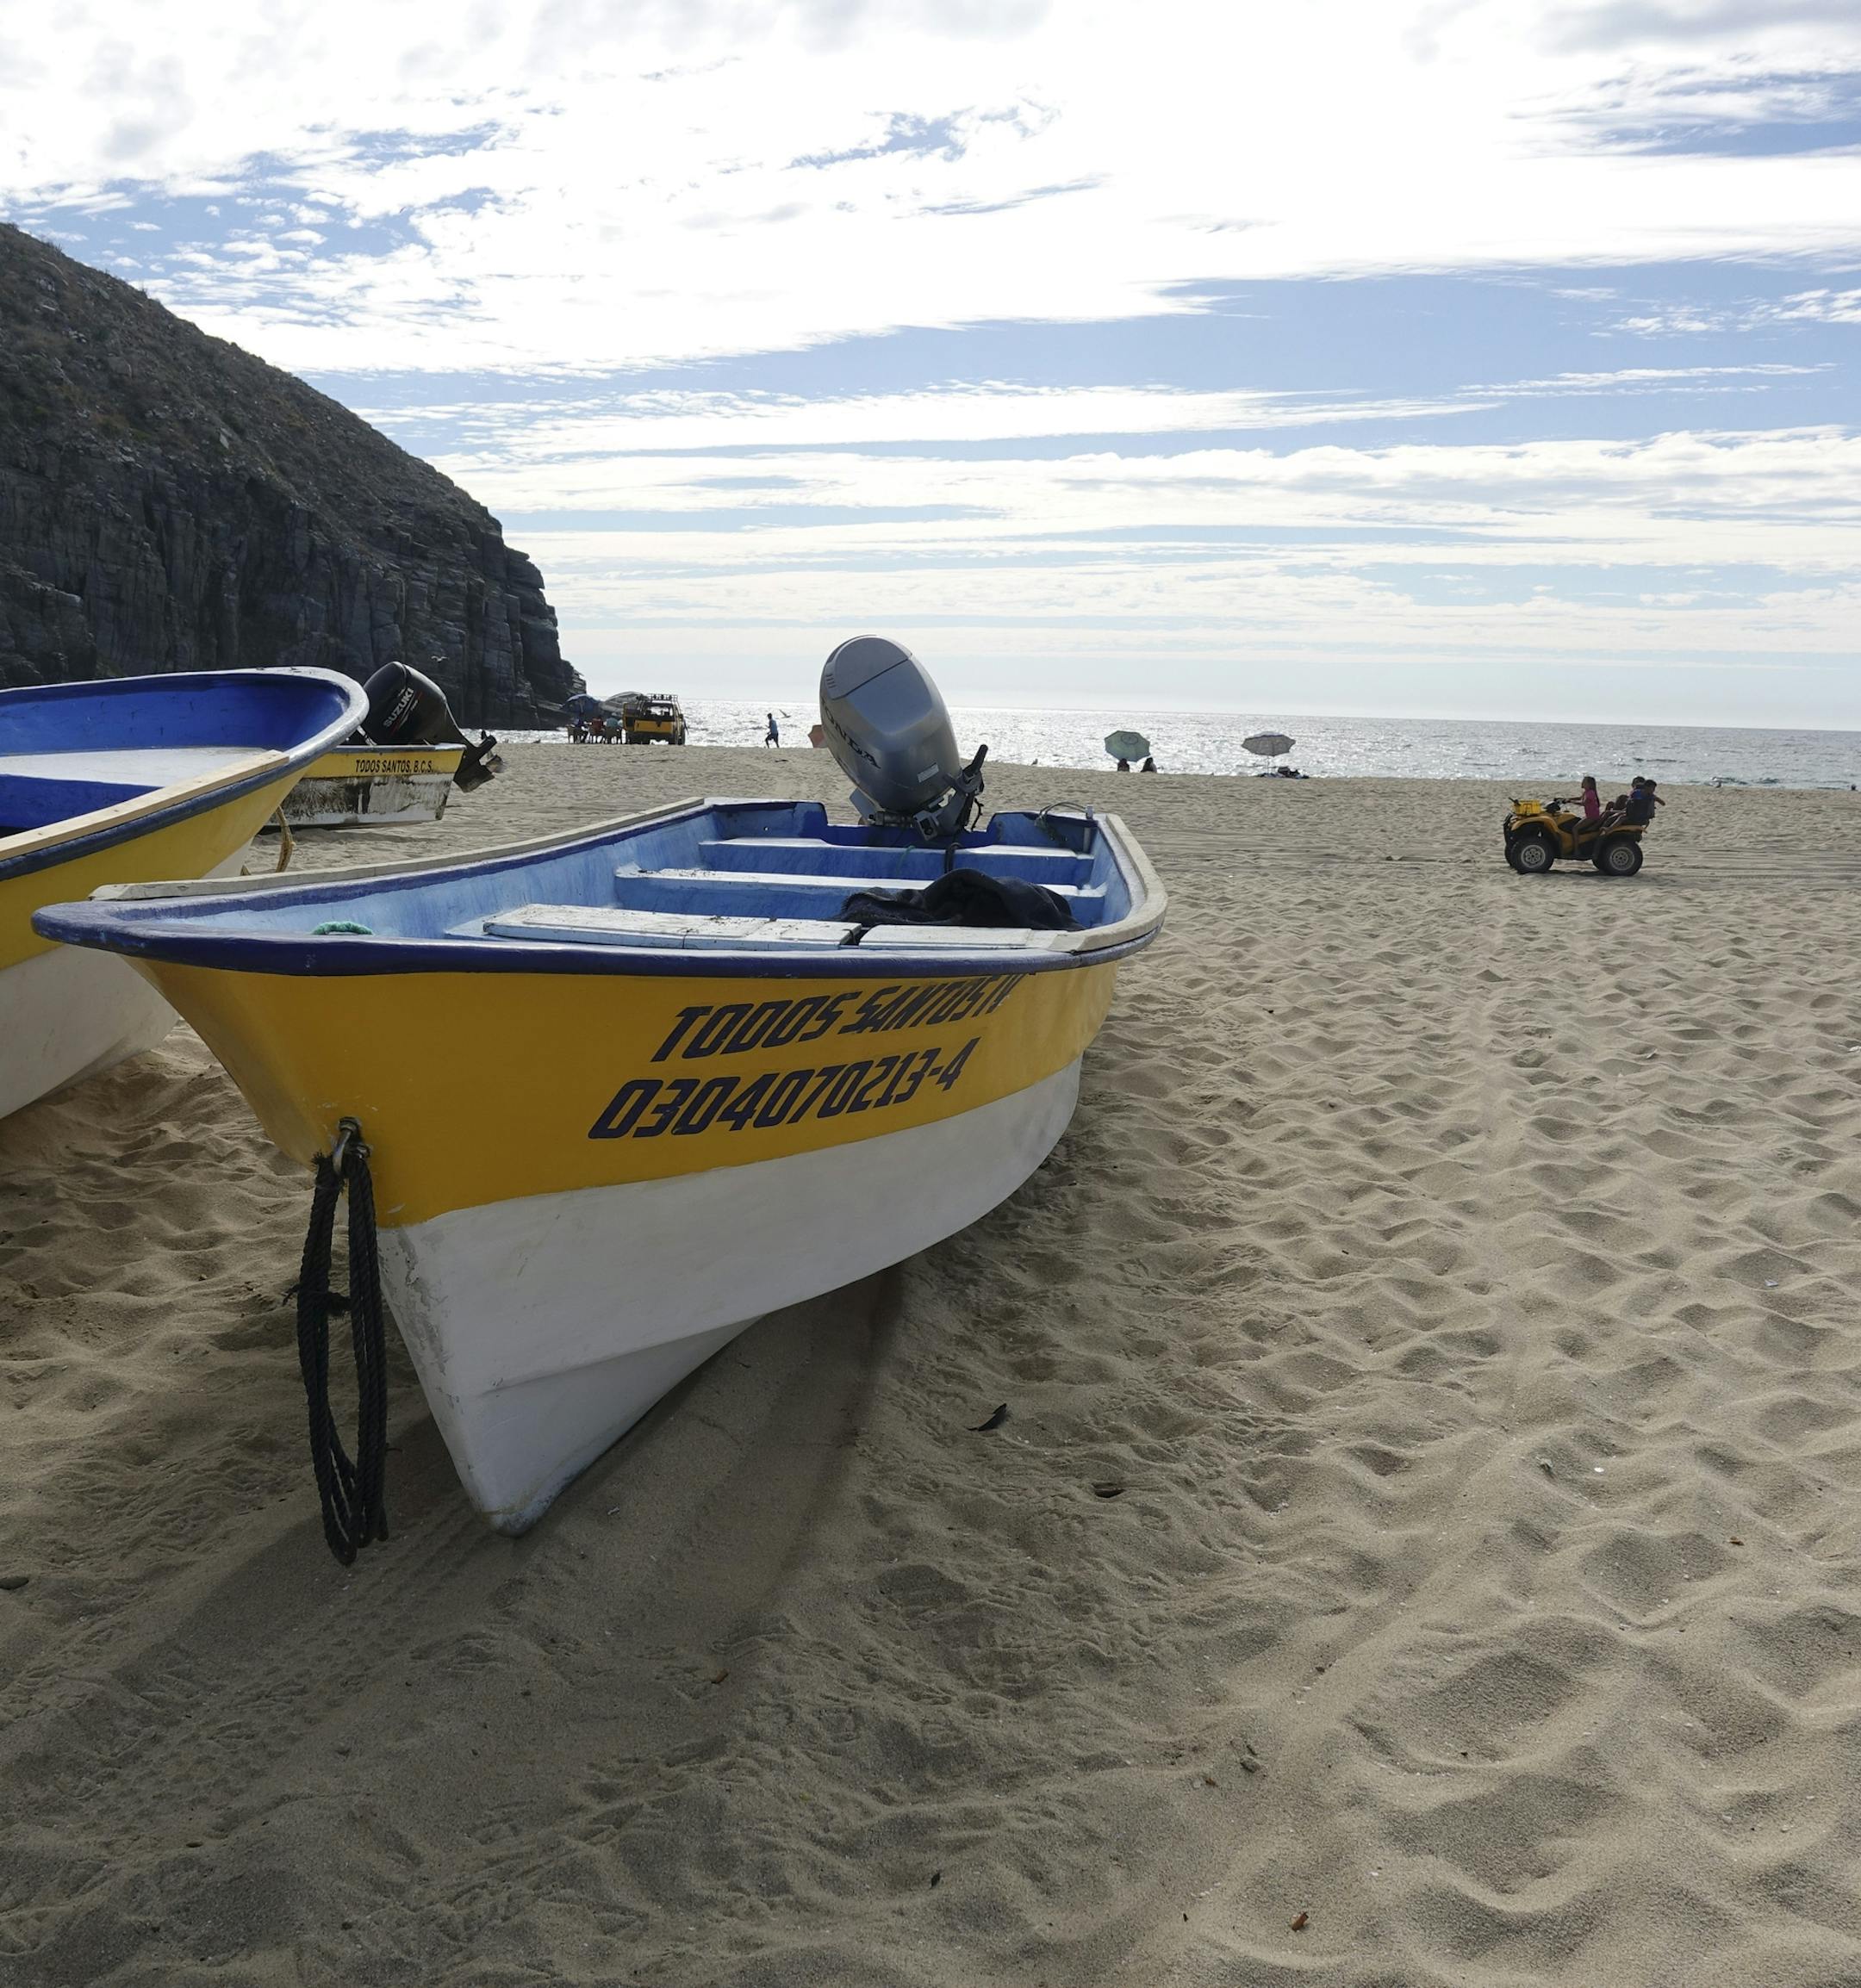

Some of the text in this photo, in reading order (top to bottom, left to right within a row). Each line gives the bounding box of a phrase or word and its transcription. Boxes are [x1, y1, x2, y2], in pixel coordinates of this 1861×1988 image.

[383, 687, 414, 727] SUZUKI
[356, 760, 380, 773] TODOS
[650, 991, 862, 1062] TODOS
[838, 973, 1000, 1034] SANTOS
[588, 1036, 982, 1140] 0304070213-4
